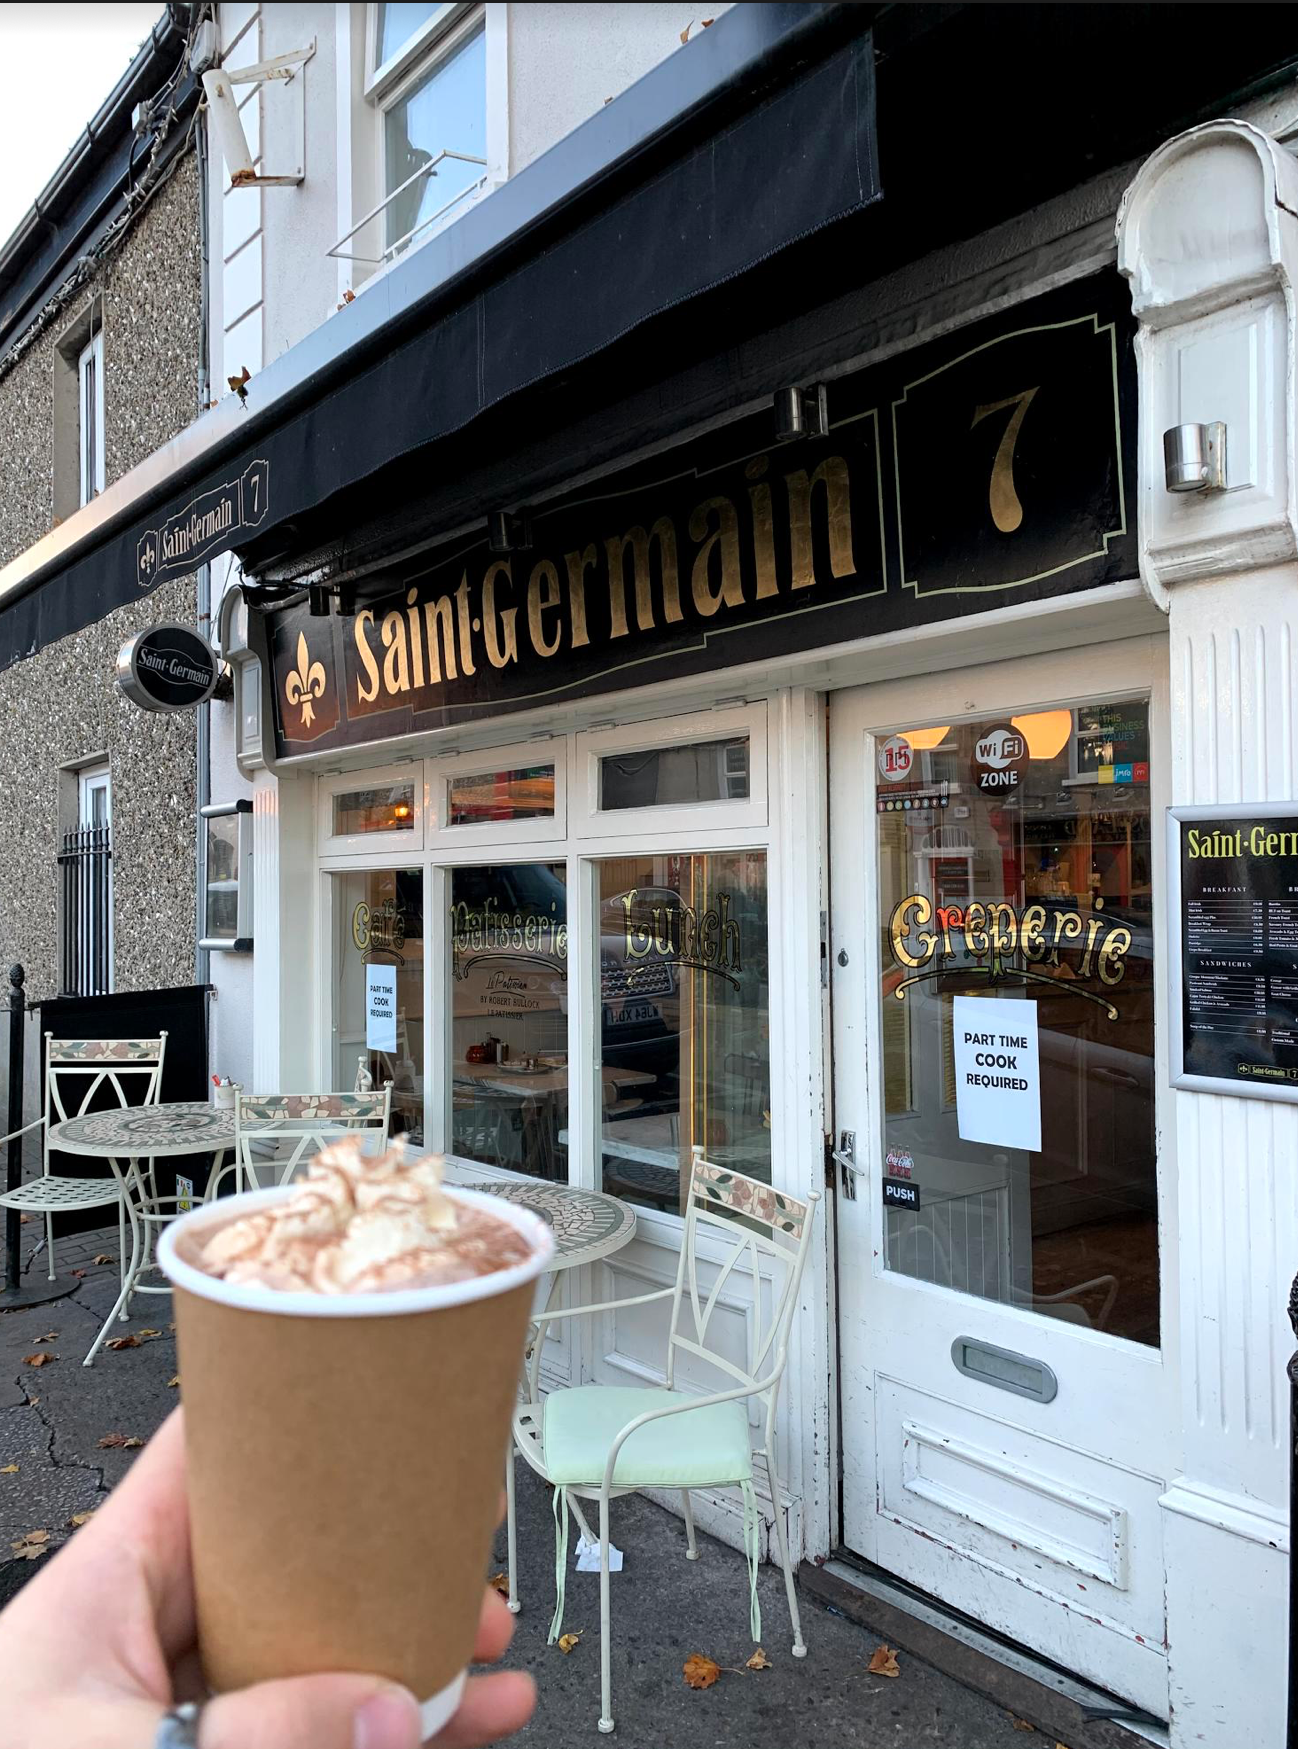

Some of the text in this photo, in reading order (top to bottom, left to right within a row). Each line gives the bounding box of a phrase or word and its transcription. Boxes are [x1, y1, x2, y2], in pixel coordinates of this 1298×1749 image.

[970, 385, 1040, 533] 7
[250, 474, 260, 513] 7
[1102, 713, 1122, 724] THIS
[884, 745, 911, 773] 15
[980, 770, 1018, 787] ZONE
[450, 896, 568, 981] Patisserie
[620, 888, 743, 974] Lunch
[888, 893, 1133, 986] Creperie
[1200, 960, 1252, 968] SANDWICHES
[373, 996, 389, 1006] COOK
[964, 1032, 1028, 1049] PART TIME
[975, 1052, 1017, 1070] COOK
[966, 1073, 1028, 1091] REQUIRED
[886, 1185, 915, 1202] PUSH
